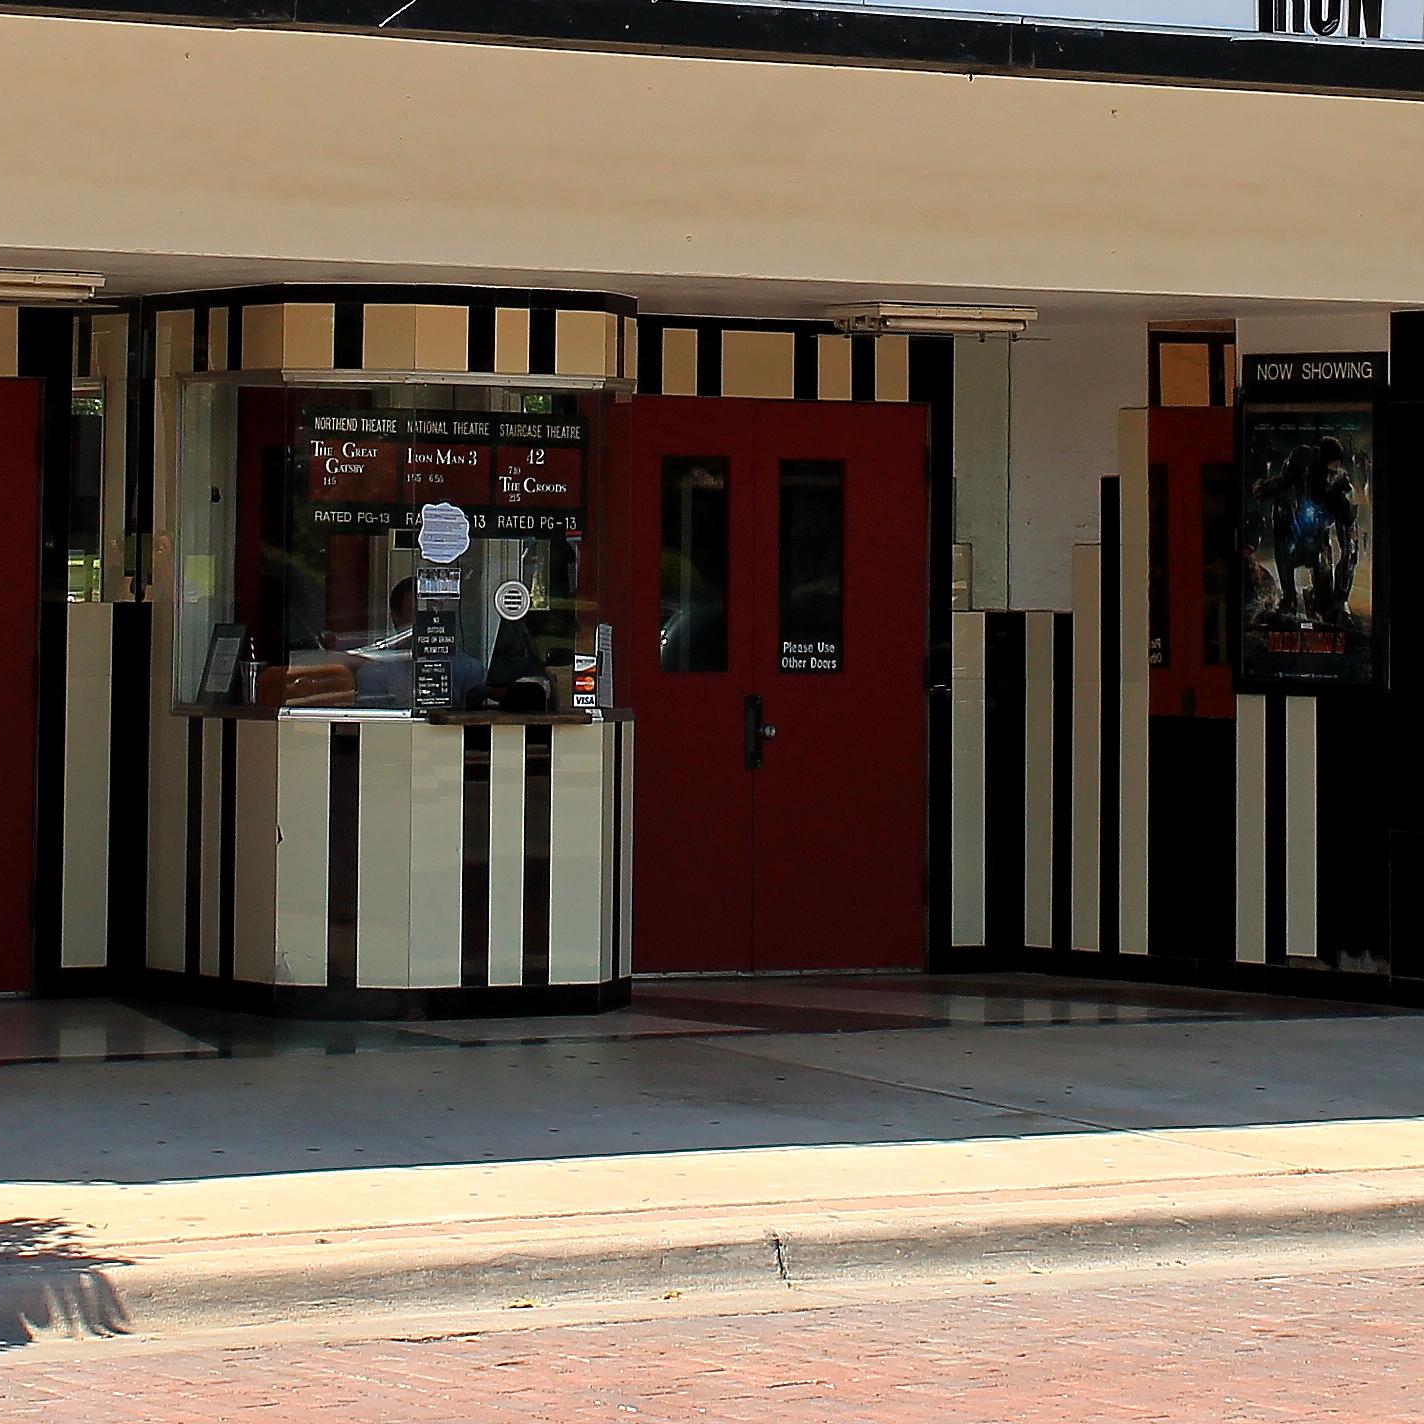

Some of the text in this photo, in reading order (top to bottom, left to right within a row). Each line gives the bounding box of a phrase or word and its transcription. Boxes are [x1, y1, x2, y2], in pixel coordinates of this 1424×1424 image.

[1257, 361, 1373, 381] NOW SHOWING
[314, 417, 397, 433] NORTHEND THEATRE
[407, 420, 490, 436] NATIONAL THEATRE
[499, 424, 581, 439] STAIRCASE THEATRE
[342, 442, 379, 458] GREAT
[468, 450, 477, 465] 3
[526, 448, 545, 465] 42
[314, 510, 390, 524] RATED PG-13
[497, 515, 577, 530] RATED PG-13
[783, 641, 835, 654] Please Use
[781, 656, 837, 669] Other Doors
[575, 696, 595, 705] VISA
